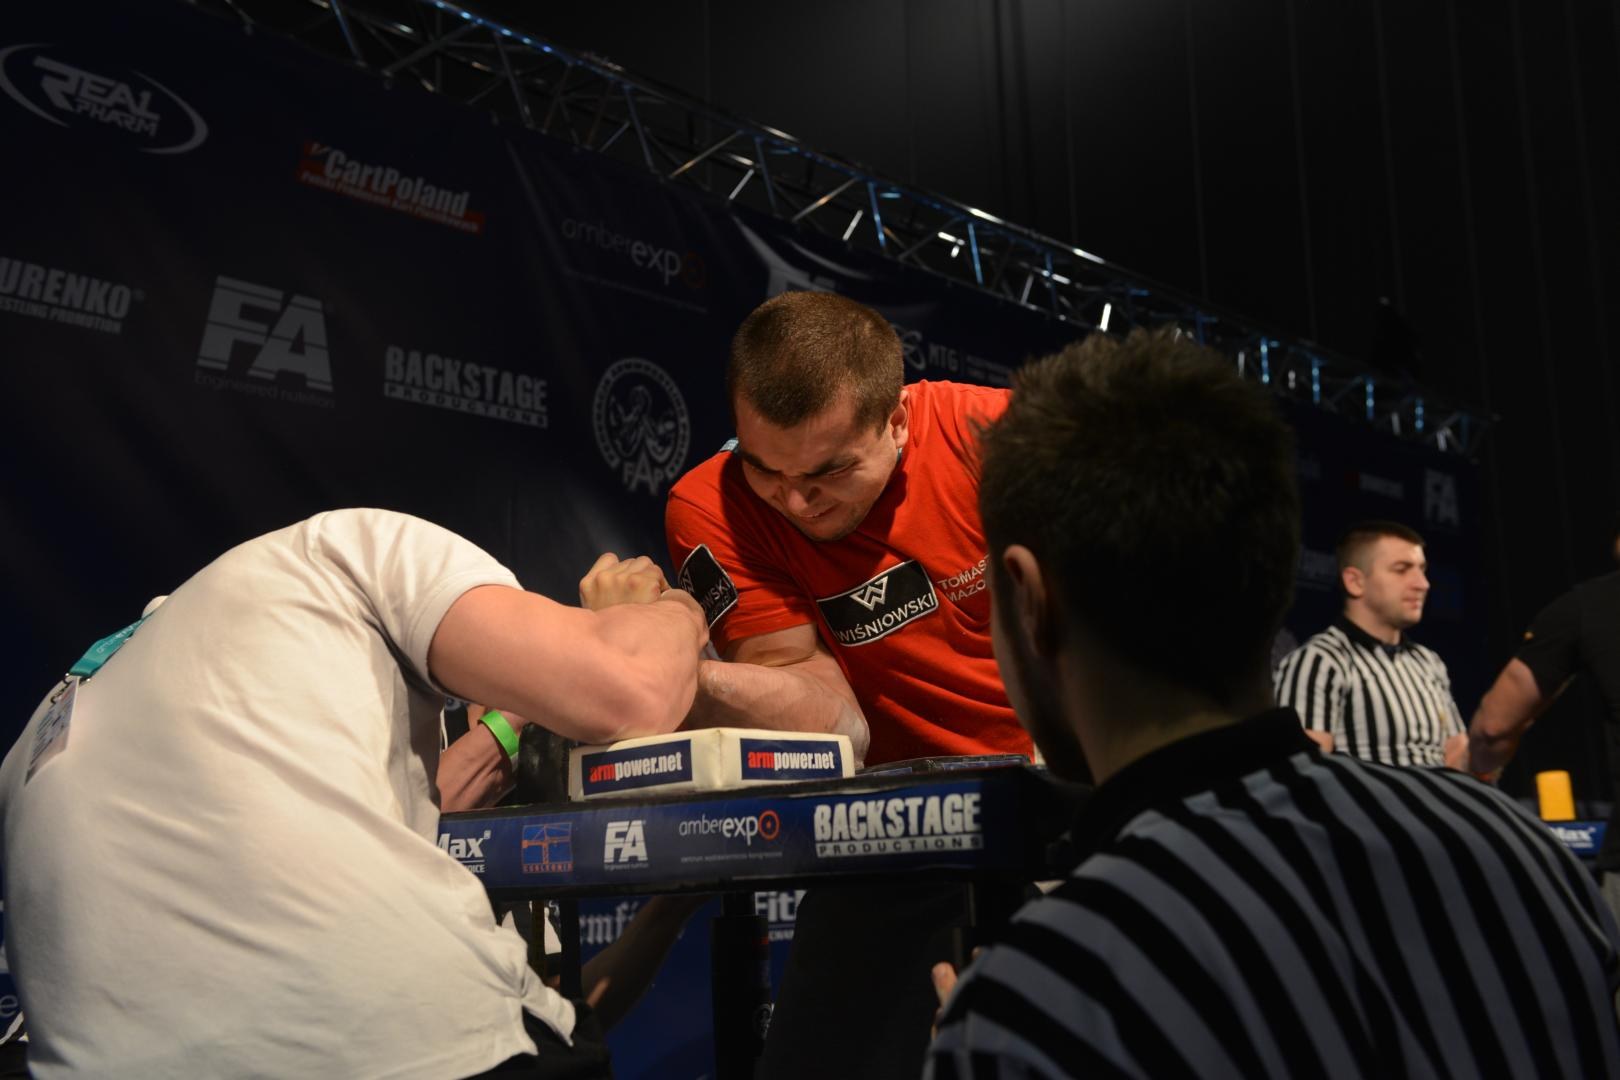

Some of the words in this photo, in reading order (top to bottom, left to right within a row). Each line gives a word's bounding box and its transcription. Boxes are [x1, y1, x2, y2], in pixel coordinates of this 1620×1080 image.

[32, 55, 161, 121] REAL
[74, 99, 159, 137] PHARM
[323, 148, 471, 219] CartPoland
[196, 274, 334, 392] FA
[384, 344, 548, 413] BACKSTAGE
[385, 383, 547, 427] PRODUCTIONS
[836, 592, 935, 643] WIŚNIOWSKI
[588, 751, 683, 784] armpower.net
[747, 750, 836, 771] armpower.net
[813, 792, 983, 842] BACKSTAGE
[603, 820, 649, 863] FA
[816, 834, 984, 857] PRODUCTIONS
